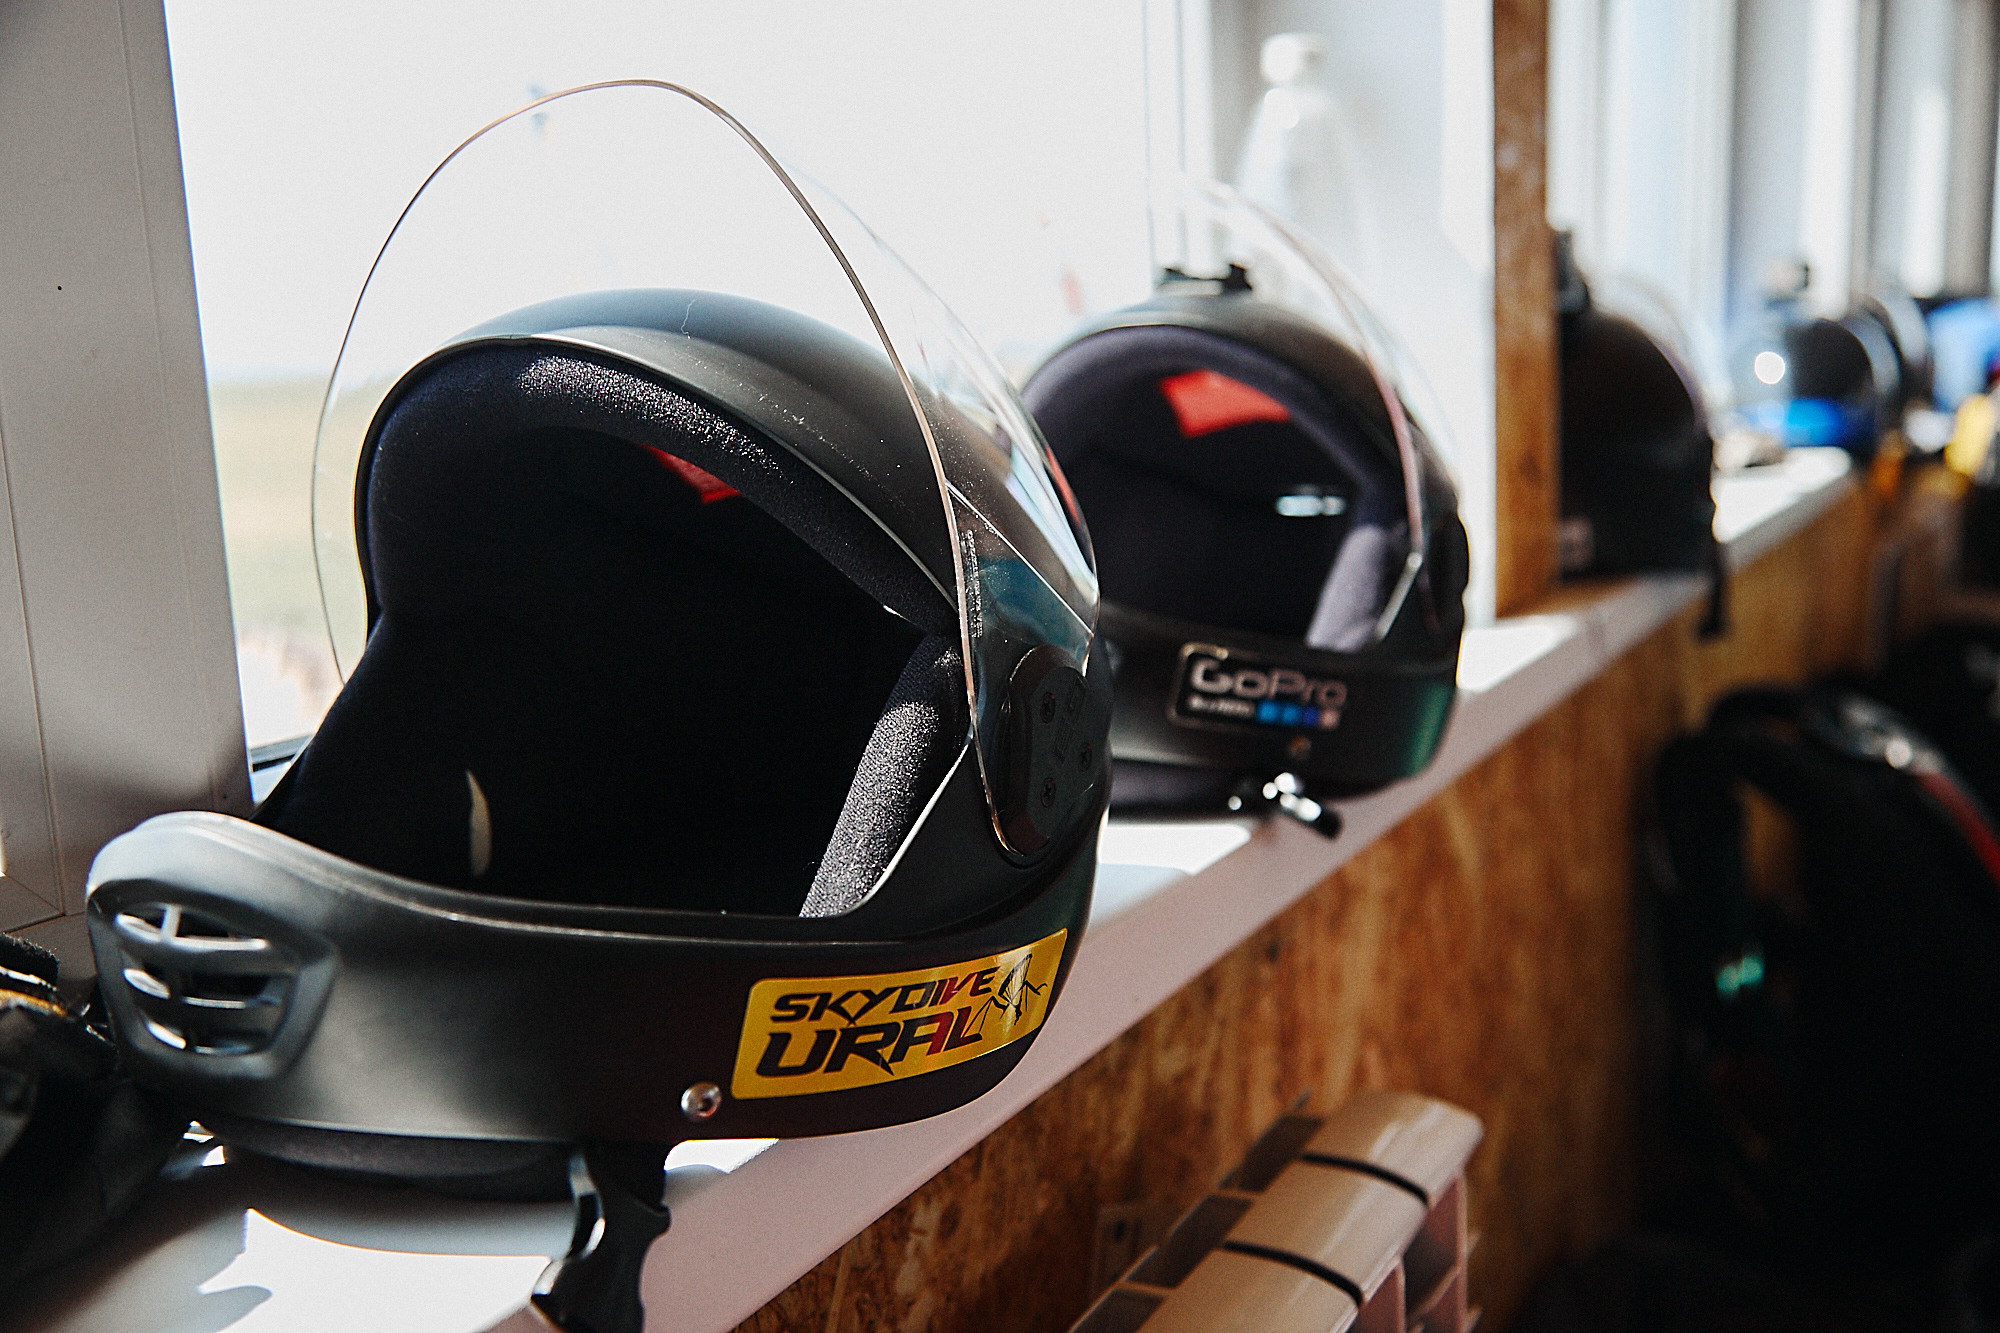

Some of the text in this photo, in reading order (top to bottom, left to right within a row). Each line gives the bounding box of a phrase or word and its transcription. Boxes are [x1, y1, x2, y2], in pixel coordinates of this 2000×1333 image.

[1191, 658, 1347, 707] GoPro
[769, 966, 1000, 1026] SKYDIVE
[755, 1005, 983, 1078] URAL
